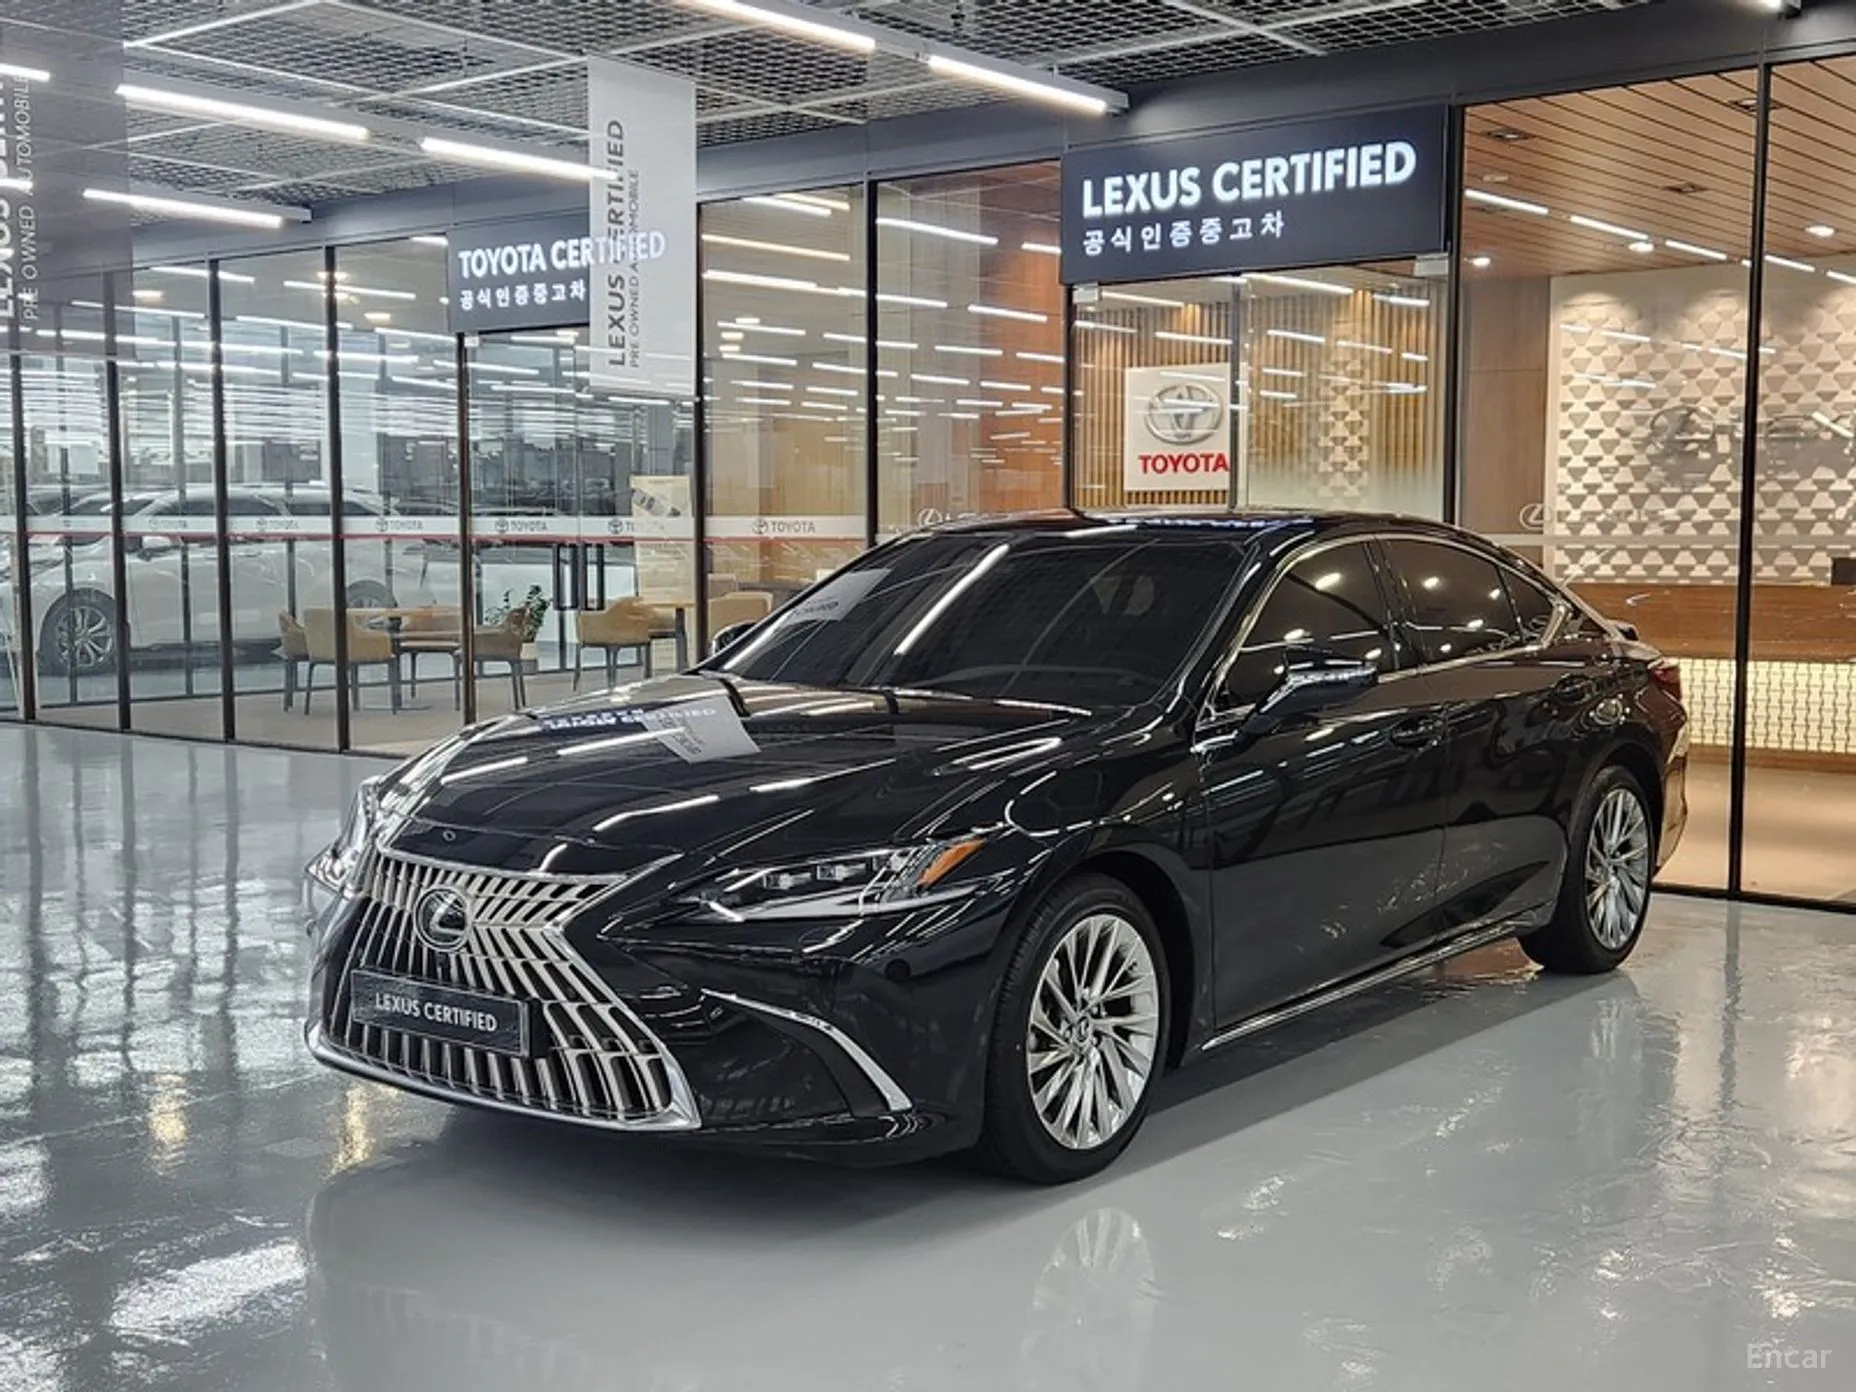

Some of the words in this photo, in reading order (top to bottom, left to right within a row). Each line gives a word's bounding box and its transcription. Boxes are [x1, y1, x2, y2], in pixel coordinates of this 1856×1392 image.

[13, 74, 34, 196] UTOMOBILE
[1082, 166, 1201, 218] LEXUS
[1211, 140, 1417, 202] CERTIFIED
[19, 205, 38, 280] OWNED
[458, 242, 547, 279] TOYOTA
[607, 274, 626, 367] LEXUS
[628, 276, 640, 334] OWNED
[629, 337, 640, 368] PRE
[1138, 452, 1231, 475] TOYOTA
[770, 519, 816, 534] TOYOTA
[374, 991, 421, 1019] LEXUS
[423, 1001, 499, 1033] CERTIFIED
